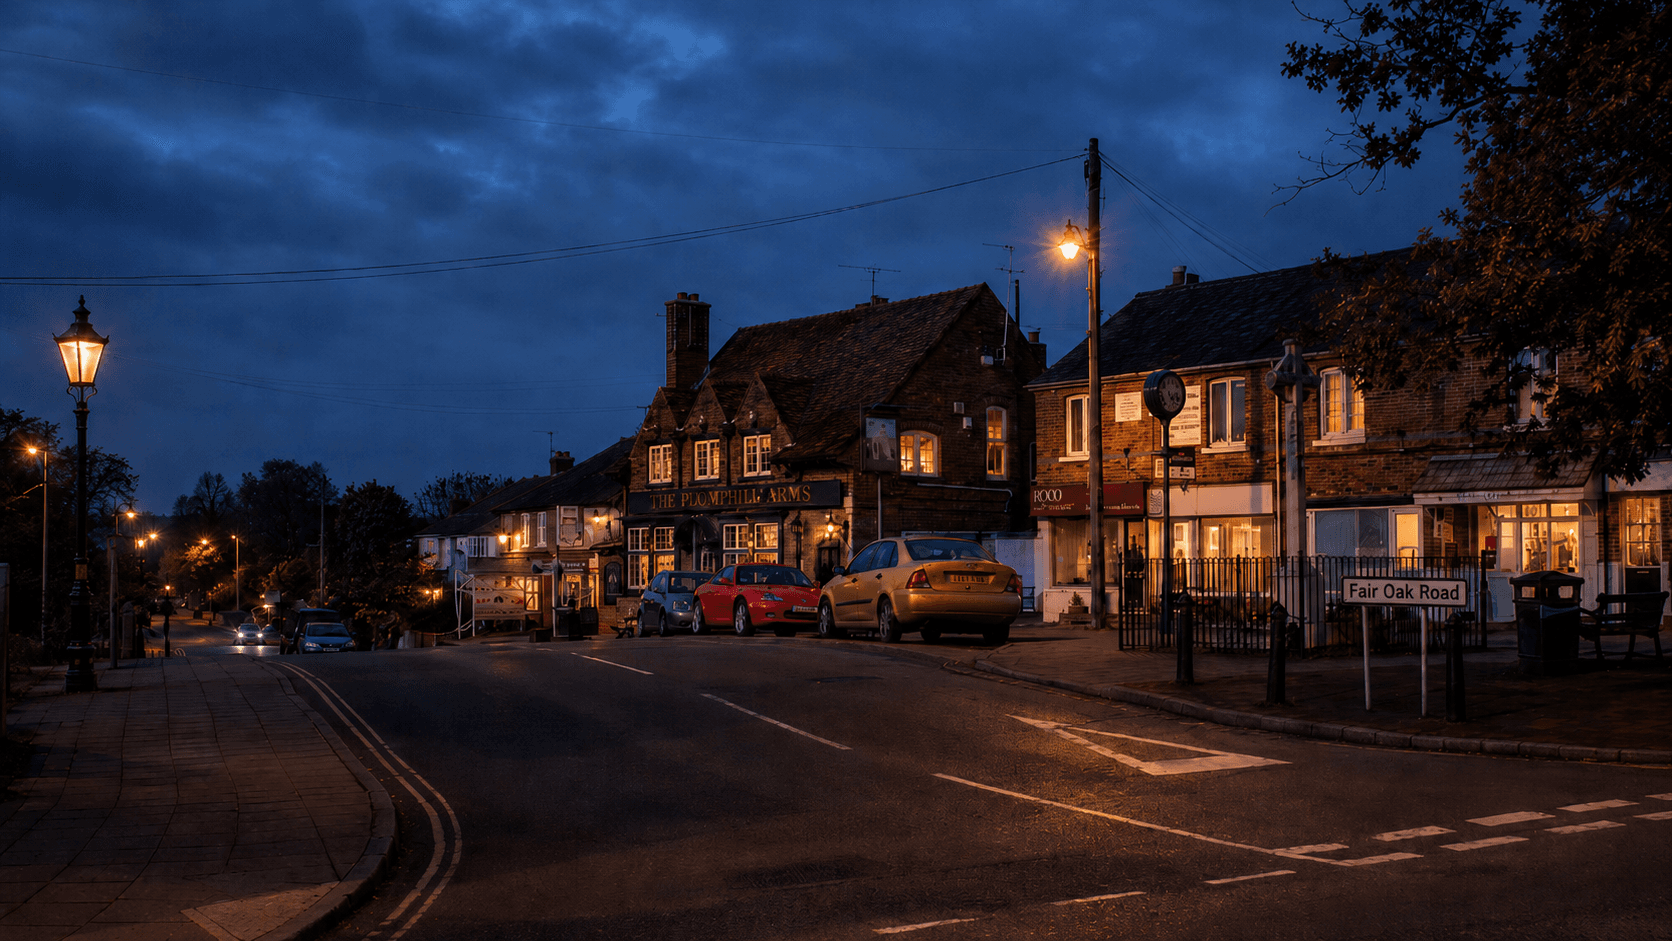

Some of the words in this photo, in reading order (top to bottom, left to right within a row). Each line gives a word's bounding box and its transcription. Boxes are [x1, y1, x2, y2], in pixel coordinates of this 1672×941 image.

[649, 493, 676, 510] THE
[767, 484, 811, 503] ARMS
[1349, 583, 1379, 598] Fair
[1383, 583, 1414, 599] Oak
[1420, 584, 1459, 600] Road
